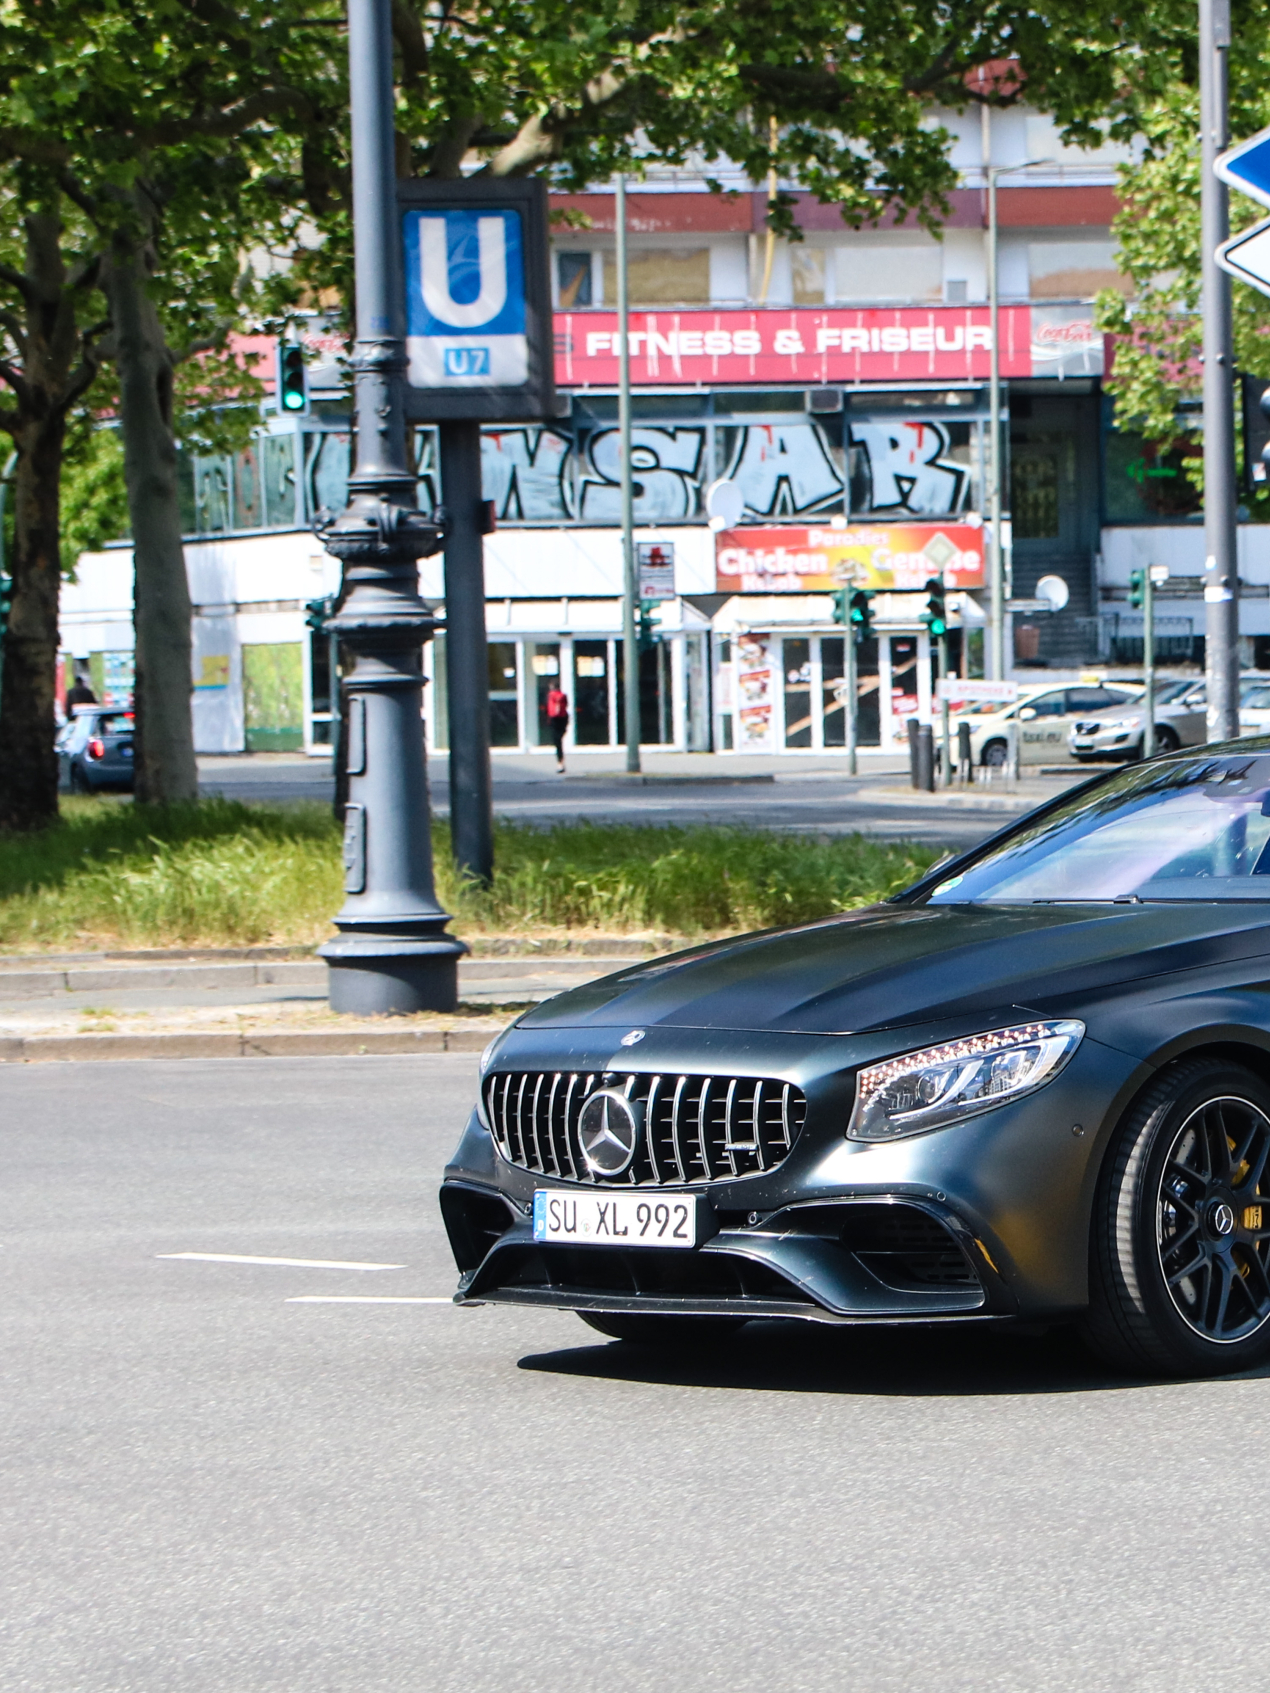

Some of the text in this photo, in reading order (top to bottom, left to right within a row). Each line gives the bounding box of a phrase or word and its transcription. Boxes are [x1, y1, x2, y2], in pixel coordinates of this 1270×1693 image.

[418, 217, 508, 329] U
[586, 329, 762, 357] FITNESS
[772, 328, 806, 356] &
[816, 326, 994, 353] FRISEUR
[448, 350, 486, 374] U7
[808, 529, 889, 548] Paradies
[718, 547, 828, 575] Chicken
[549, 1199, 577, 1233] SU
[596, 1201, 629, 1236] XL
[636, 1203, 689, 1239] 992
